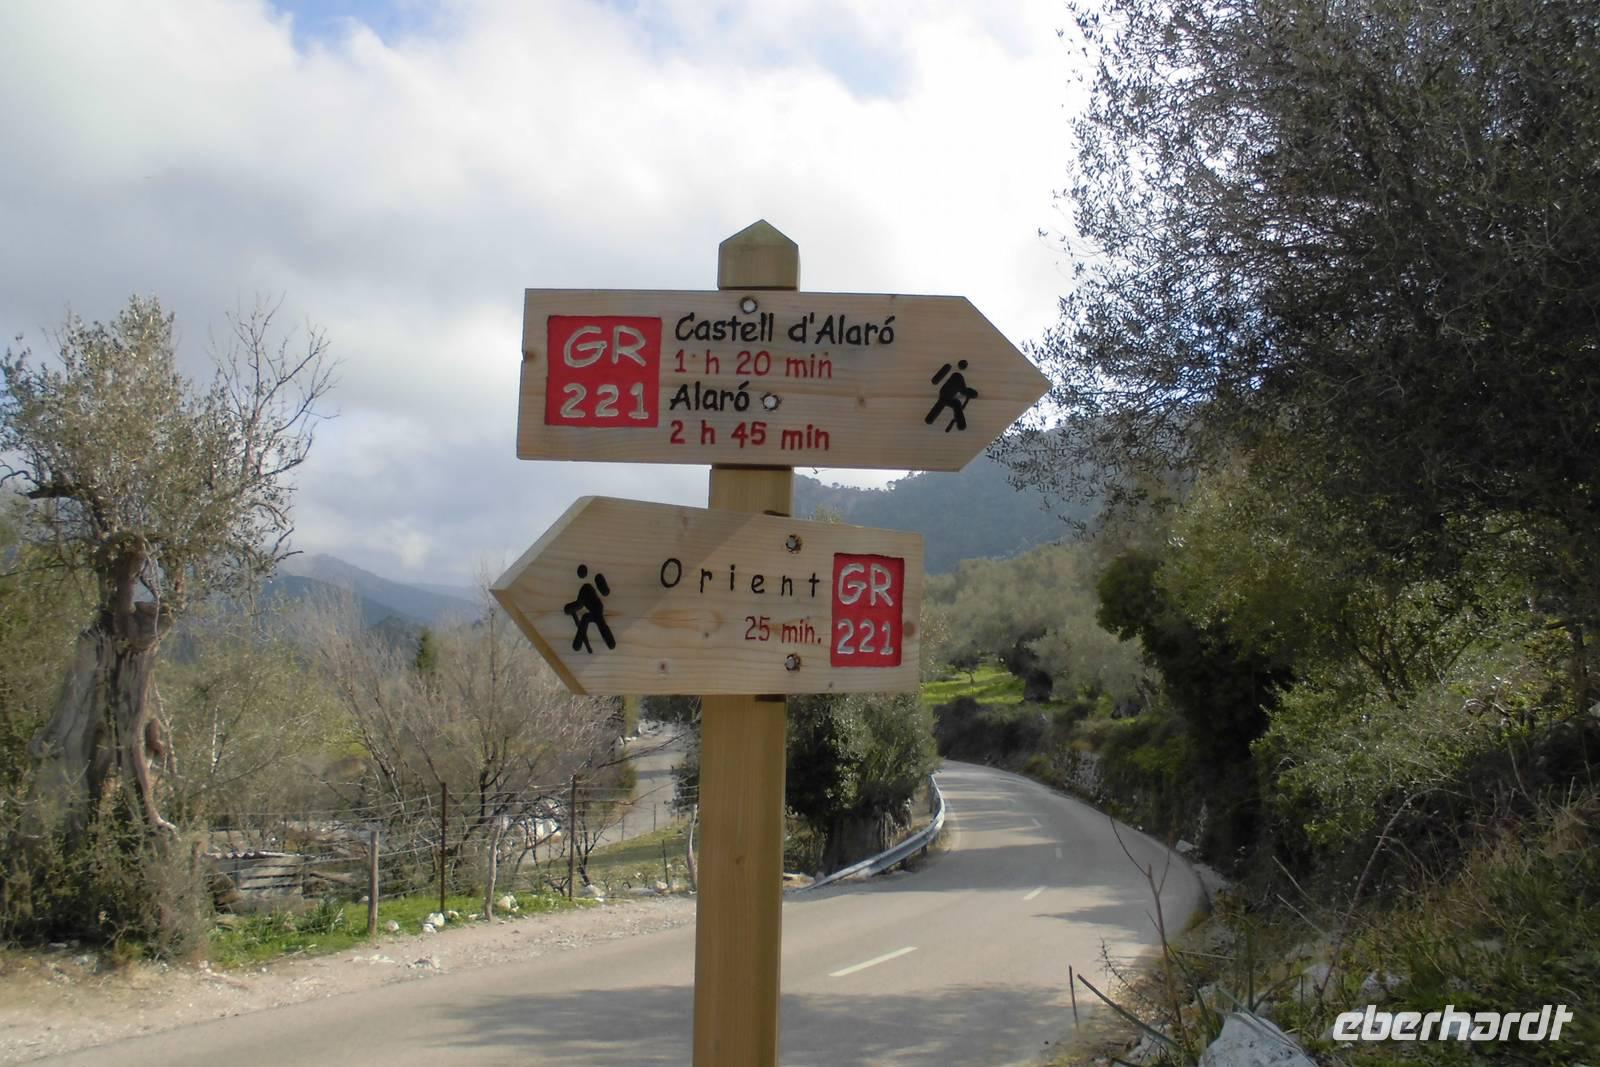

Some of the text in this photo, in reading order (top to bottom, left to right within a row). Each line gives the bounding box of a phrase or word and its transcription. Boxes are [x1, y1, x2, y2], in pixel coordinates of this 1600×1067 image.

[675, 311, 895, 345] Castell d'Alaró
[563, 325, 647, 367] GR
[674, 351, 832, 379] 1 h 20 min
[560, 382, 649, 420] 221
[669, 381, 750, 412] Alaró
[670, 421, 829, 450] 2 h 45 min
[660, 558, 820, 597] Orient
[837, 562, 893, 606] GR
[745, 616, 822, 644] 25 min.
[837, 619, 893, 655] 221
